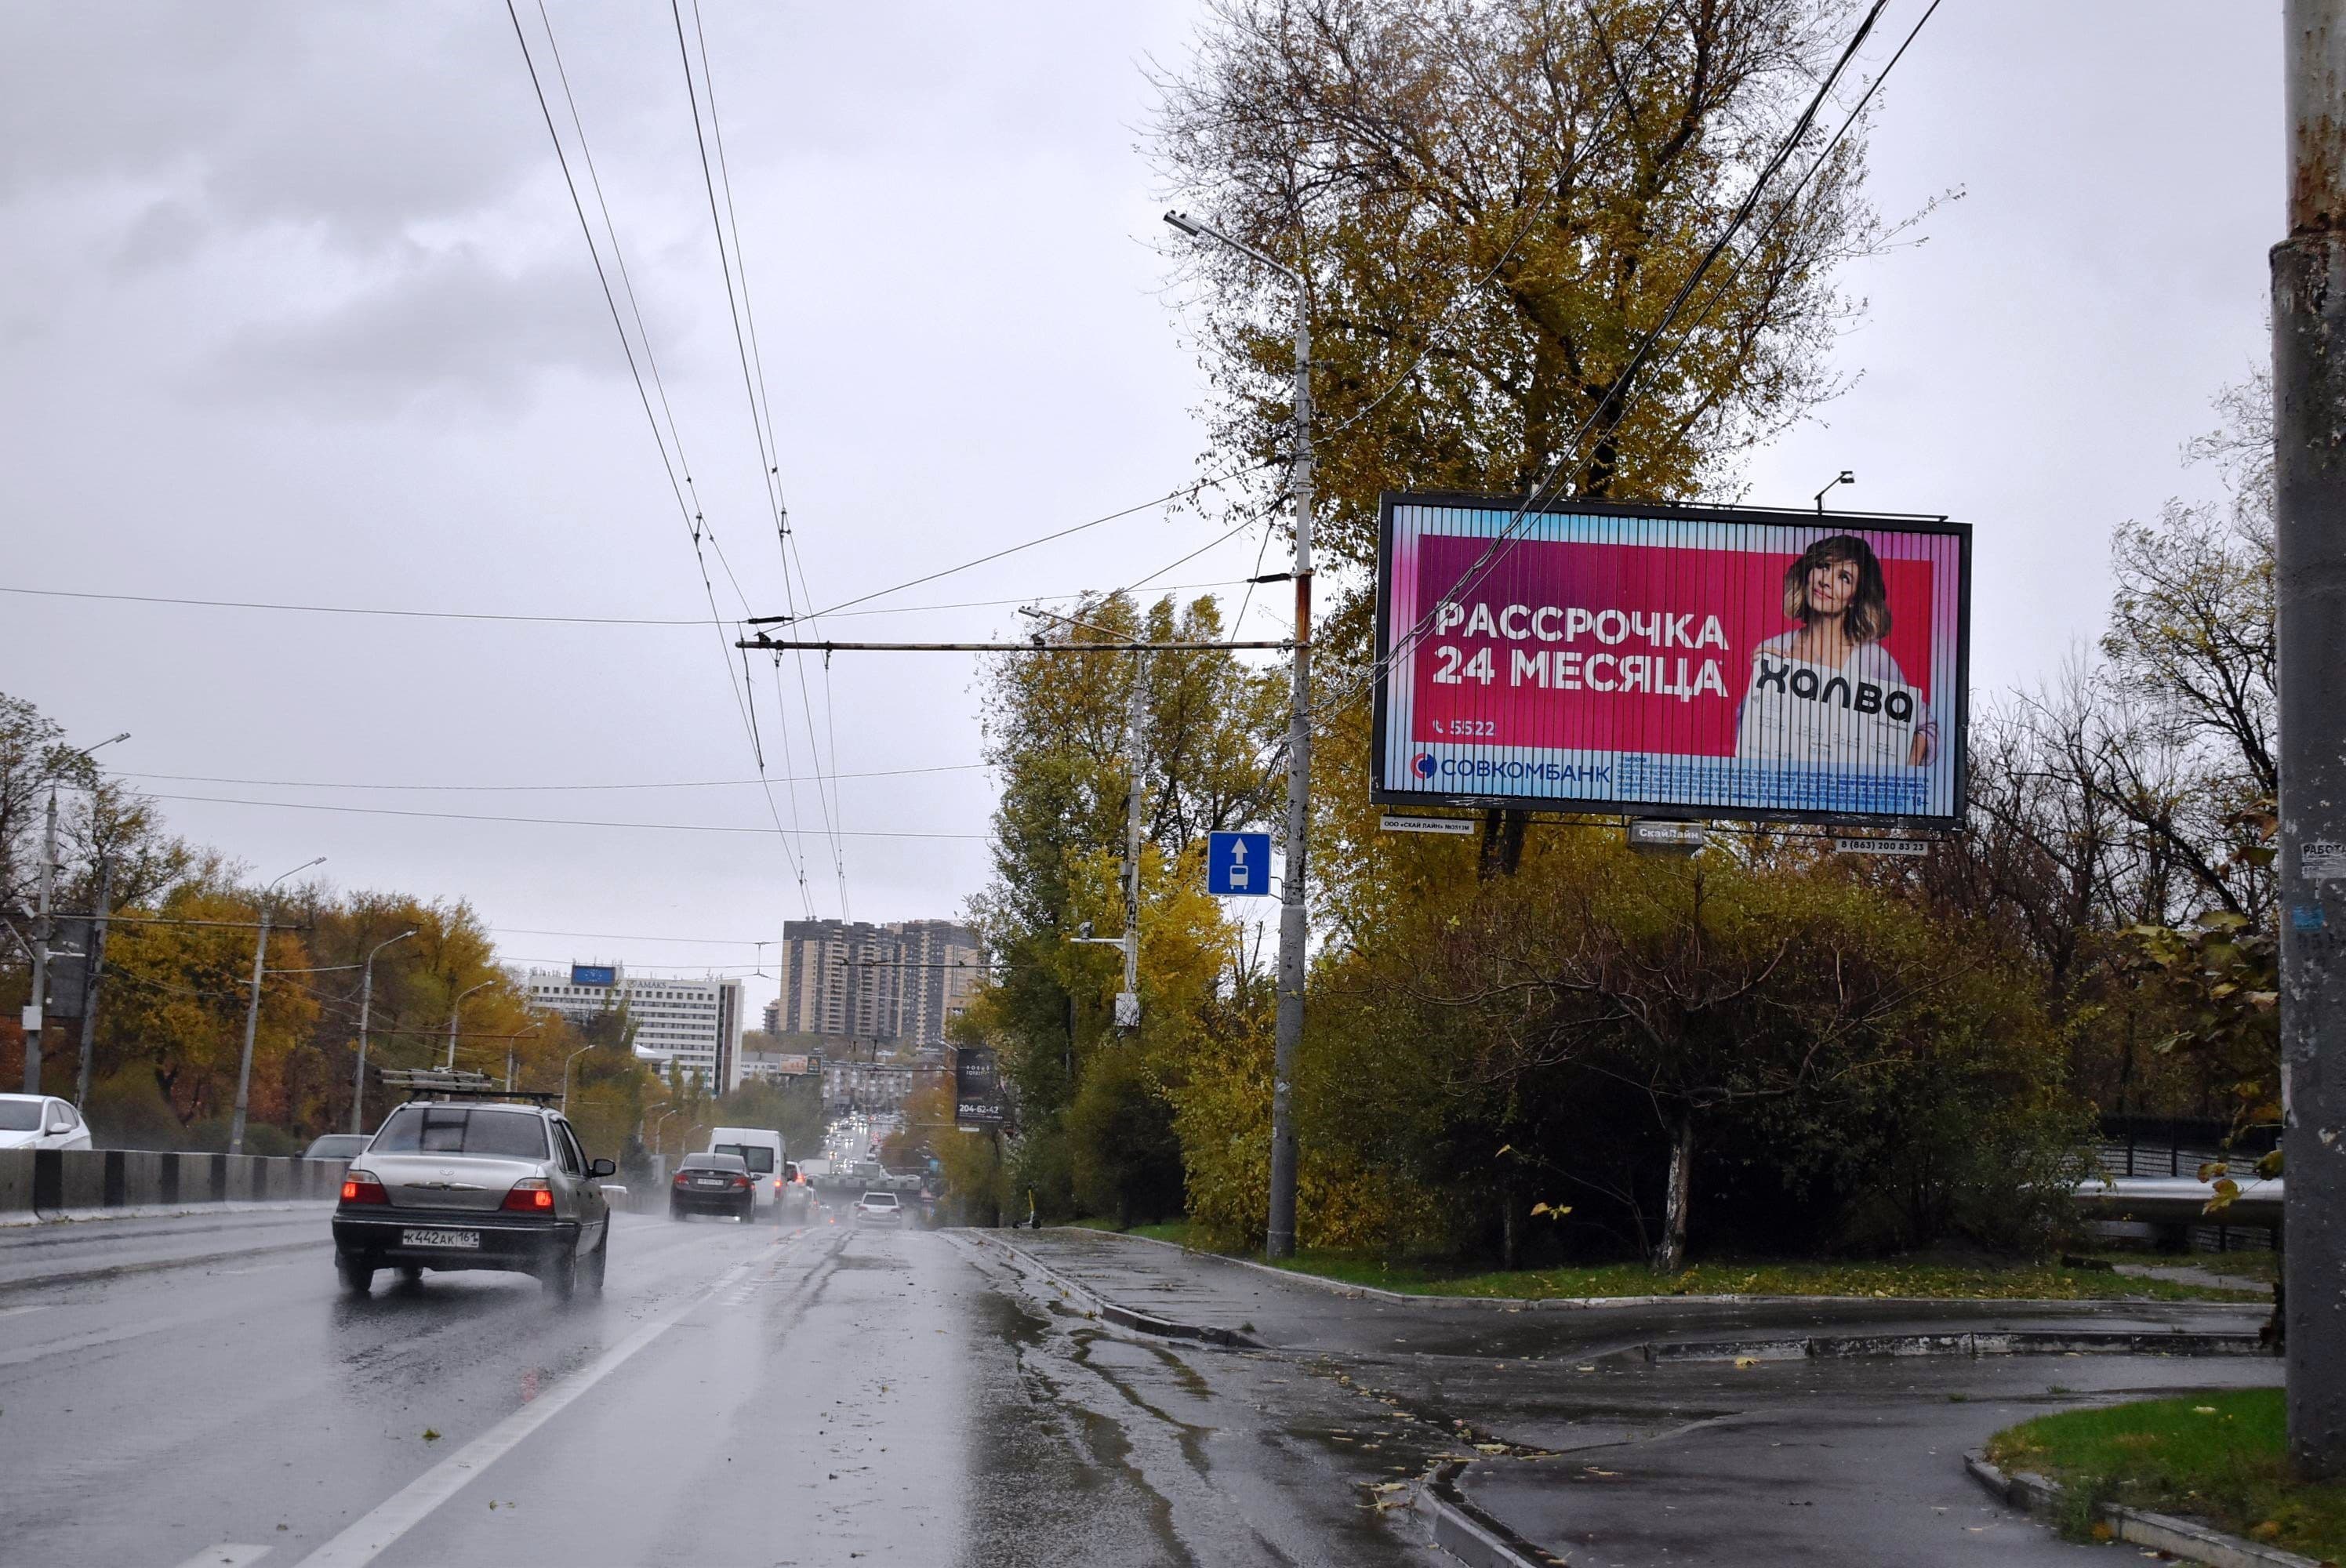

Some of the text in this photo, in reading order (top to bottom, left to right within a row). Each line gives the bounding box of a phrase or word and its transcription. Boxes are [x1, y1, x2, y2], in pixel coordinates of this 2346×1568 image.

[1435, 601, 1730, 651] РАССРОЧКА
[1433, 645, 1495, 685] 24
[1450, 720, 1495, 736] 5522
[1440, 759, 1611, 783] СОВКОМБАНК
[1850, 840, 1875, 851] (863)
